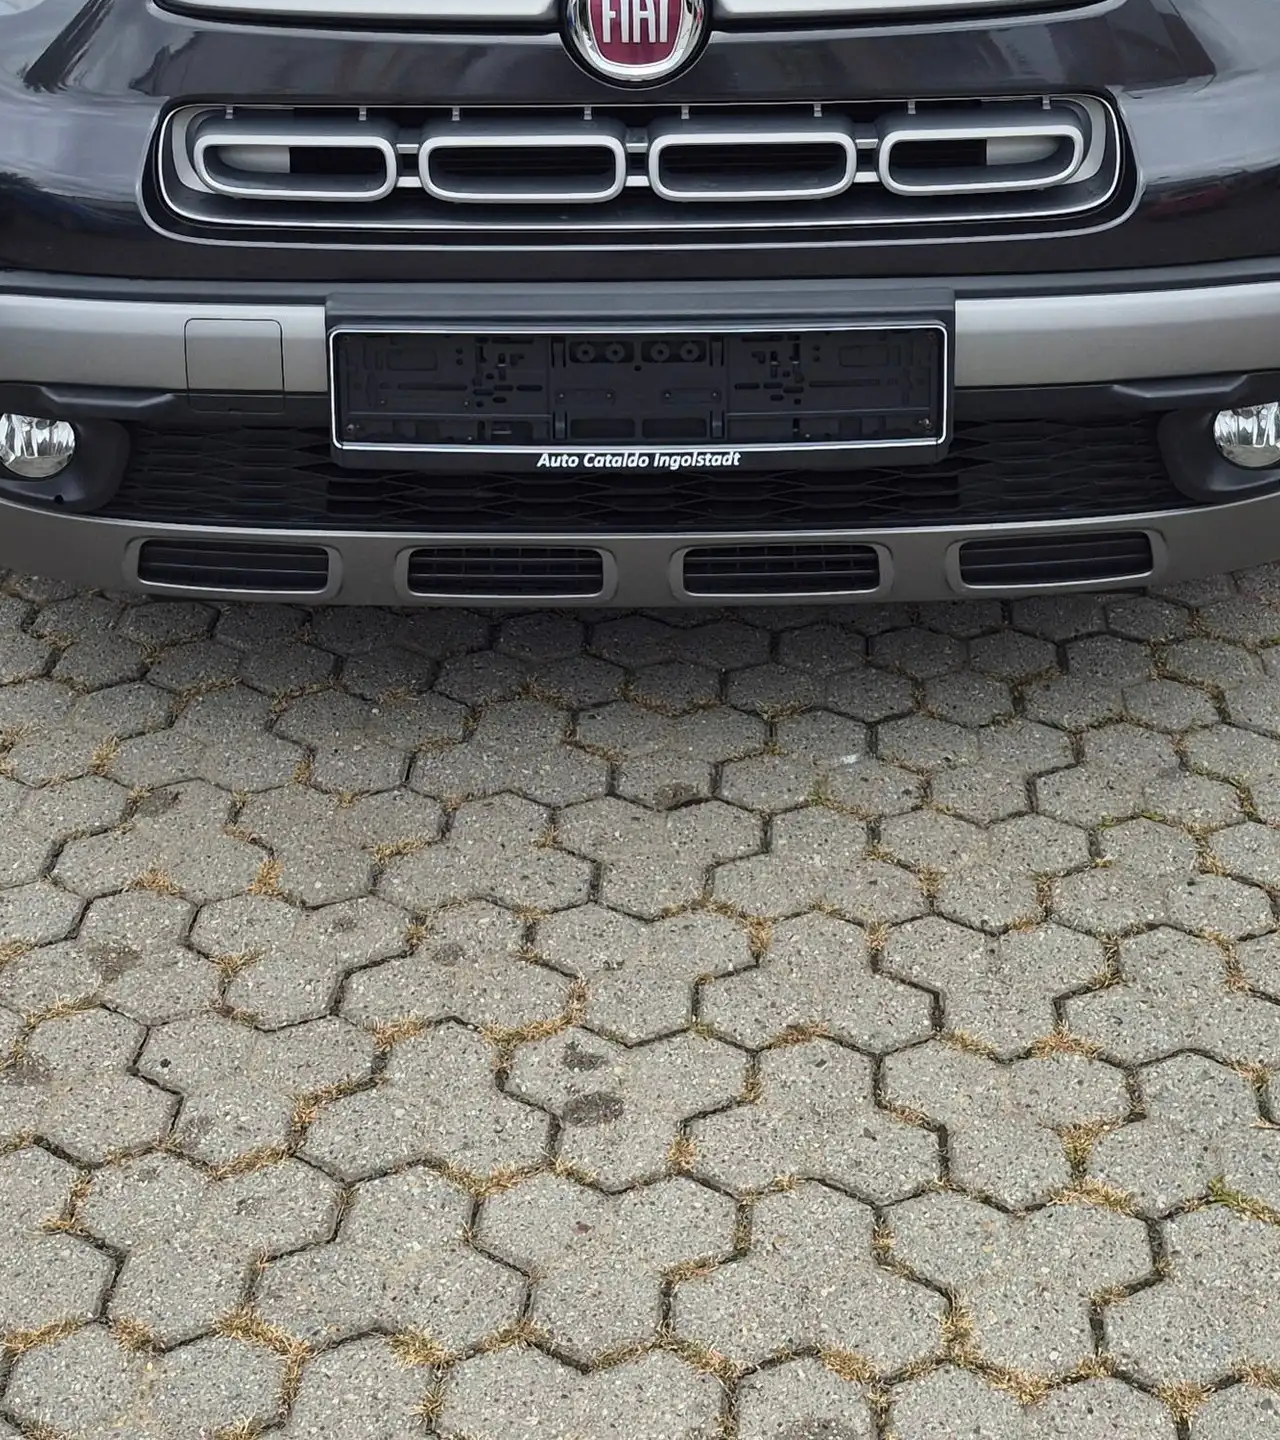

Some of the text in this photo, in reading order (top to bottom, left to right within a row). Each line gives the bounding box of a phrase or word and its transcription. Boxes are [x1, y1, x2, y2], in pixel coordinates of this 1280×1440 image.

[537, 450, 741, 471] Auto Cataldo Ingolstadt
